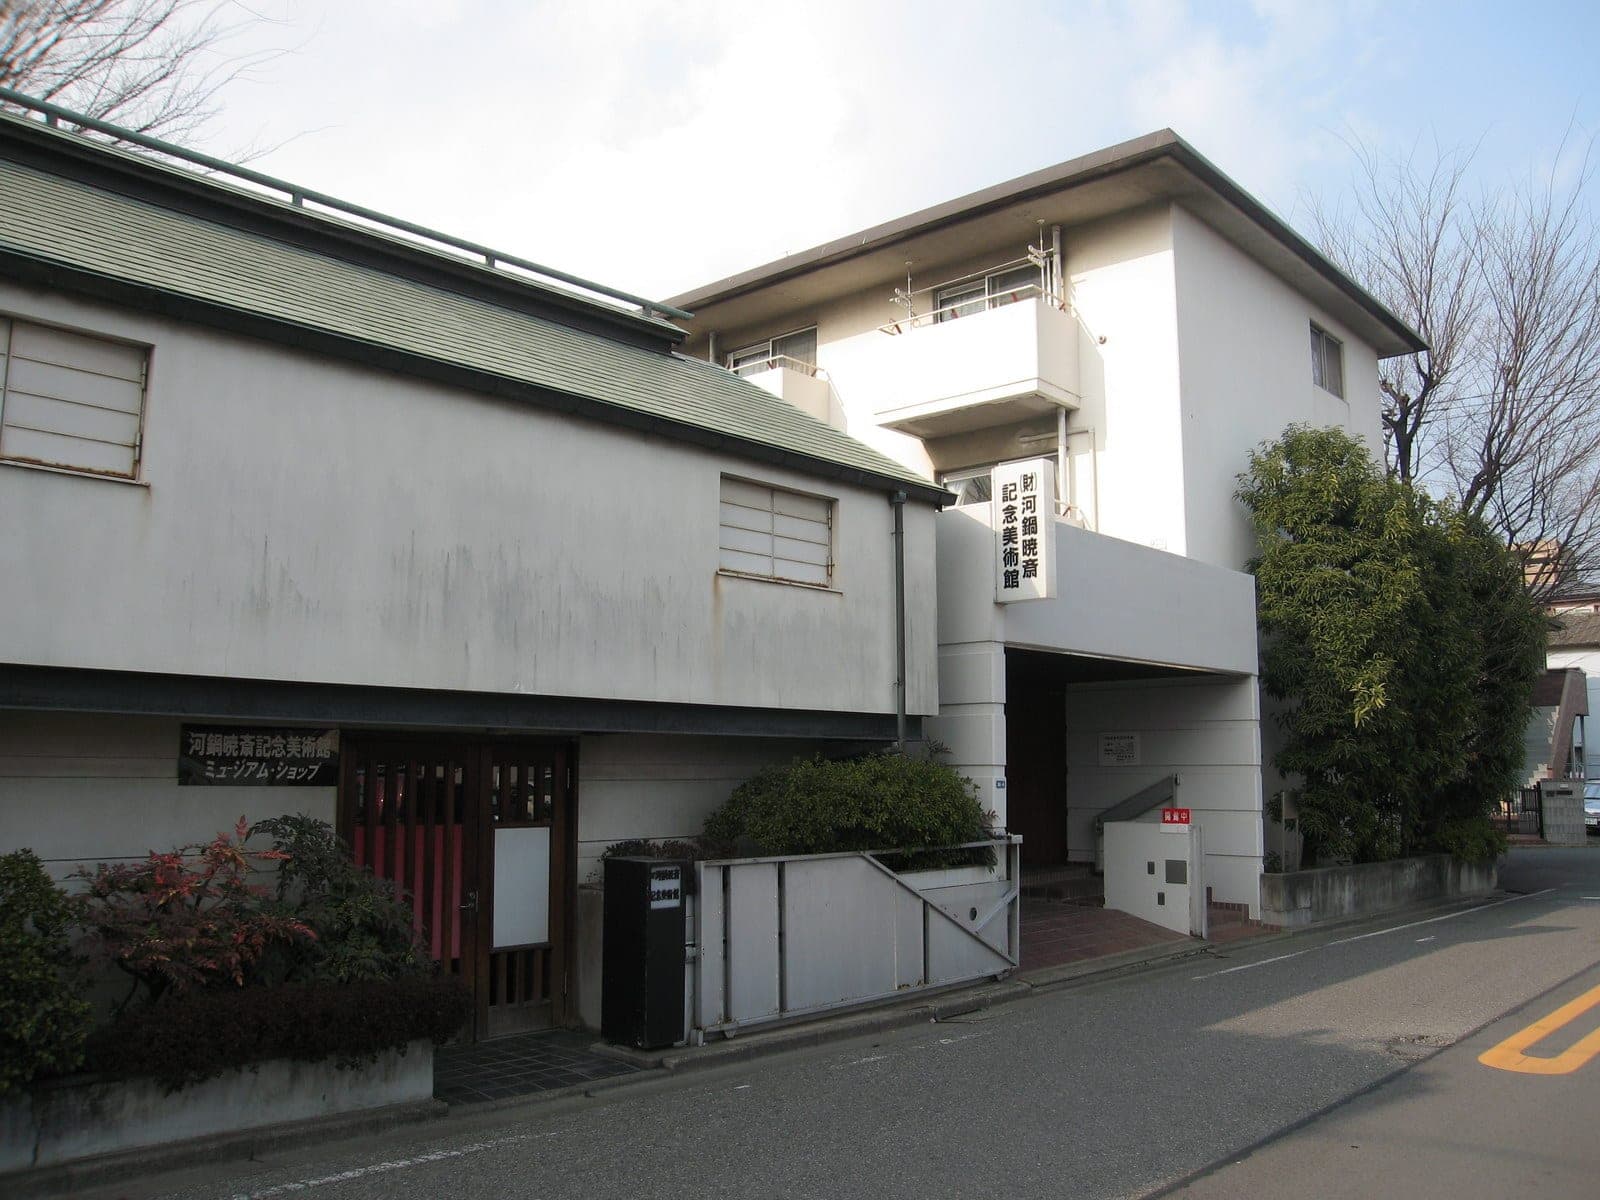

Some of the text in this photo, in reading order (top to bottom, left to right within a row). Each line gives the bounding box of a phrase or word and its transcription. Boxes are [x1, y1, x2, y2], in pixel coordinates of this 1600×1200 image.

[1002, 482, 1020, 589] 記念美術館
[188, 731, 331, 758] 河鍋暁斎記念美術館
